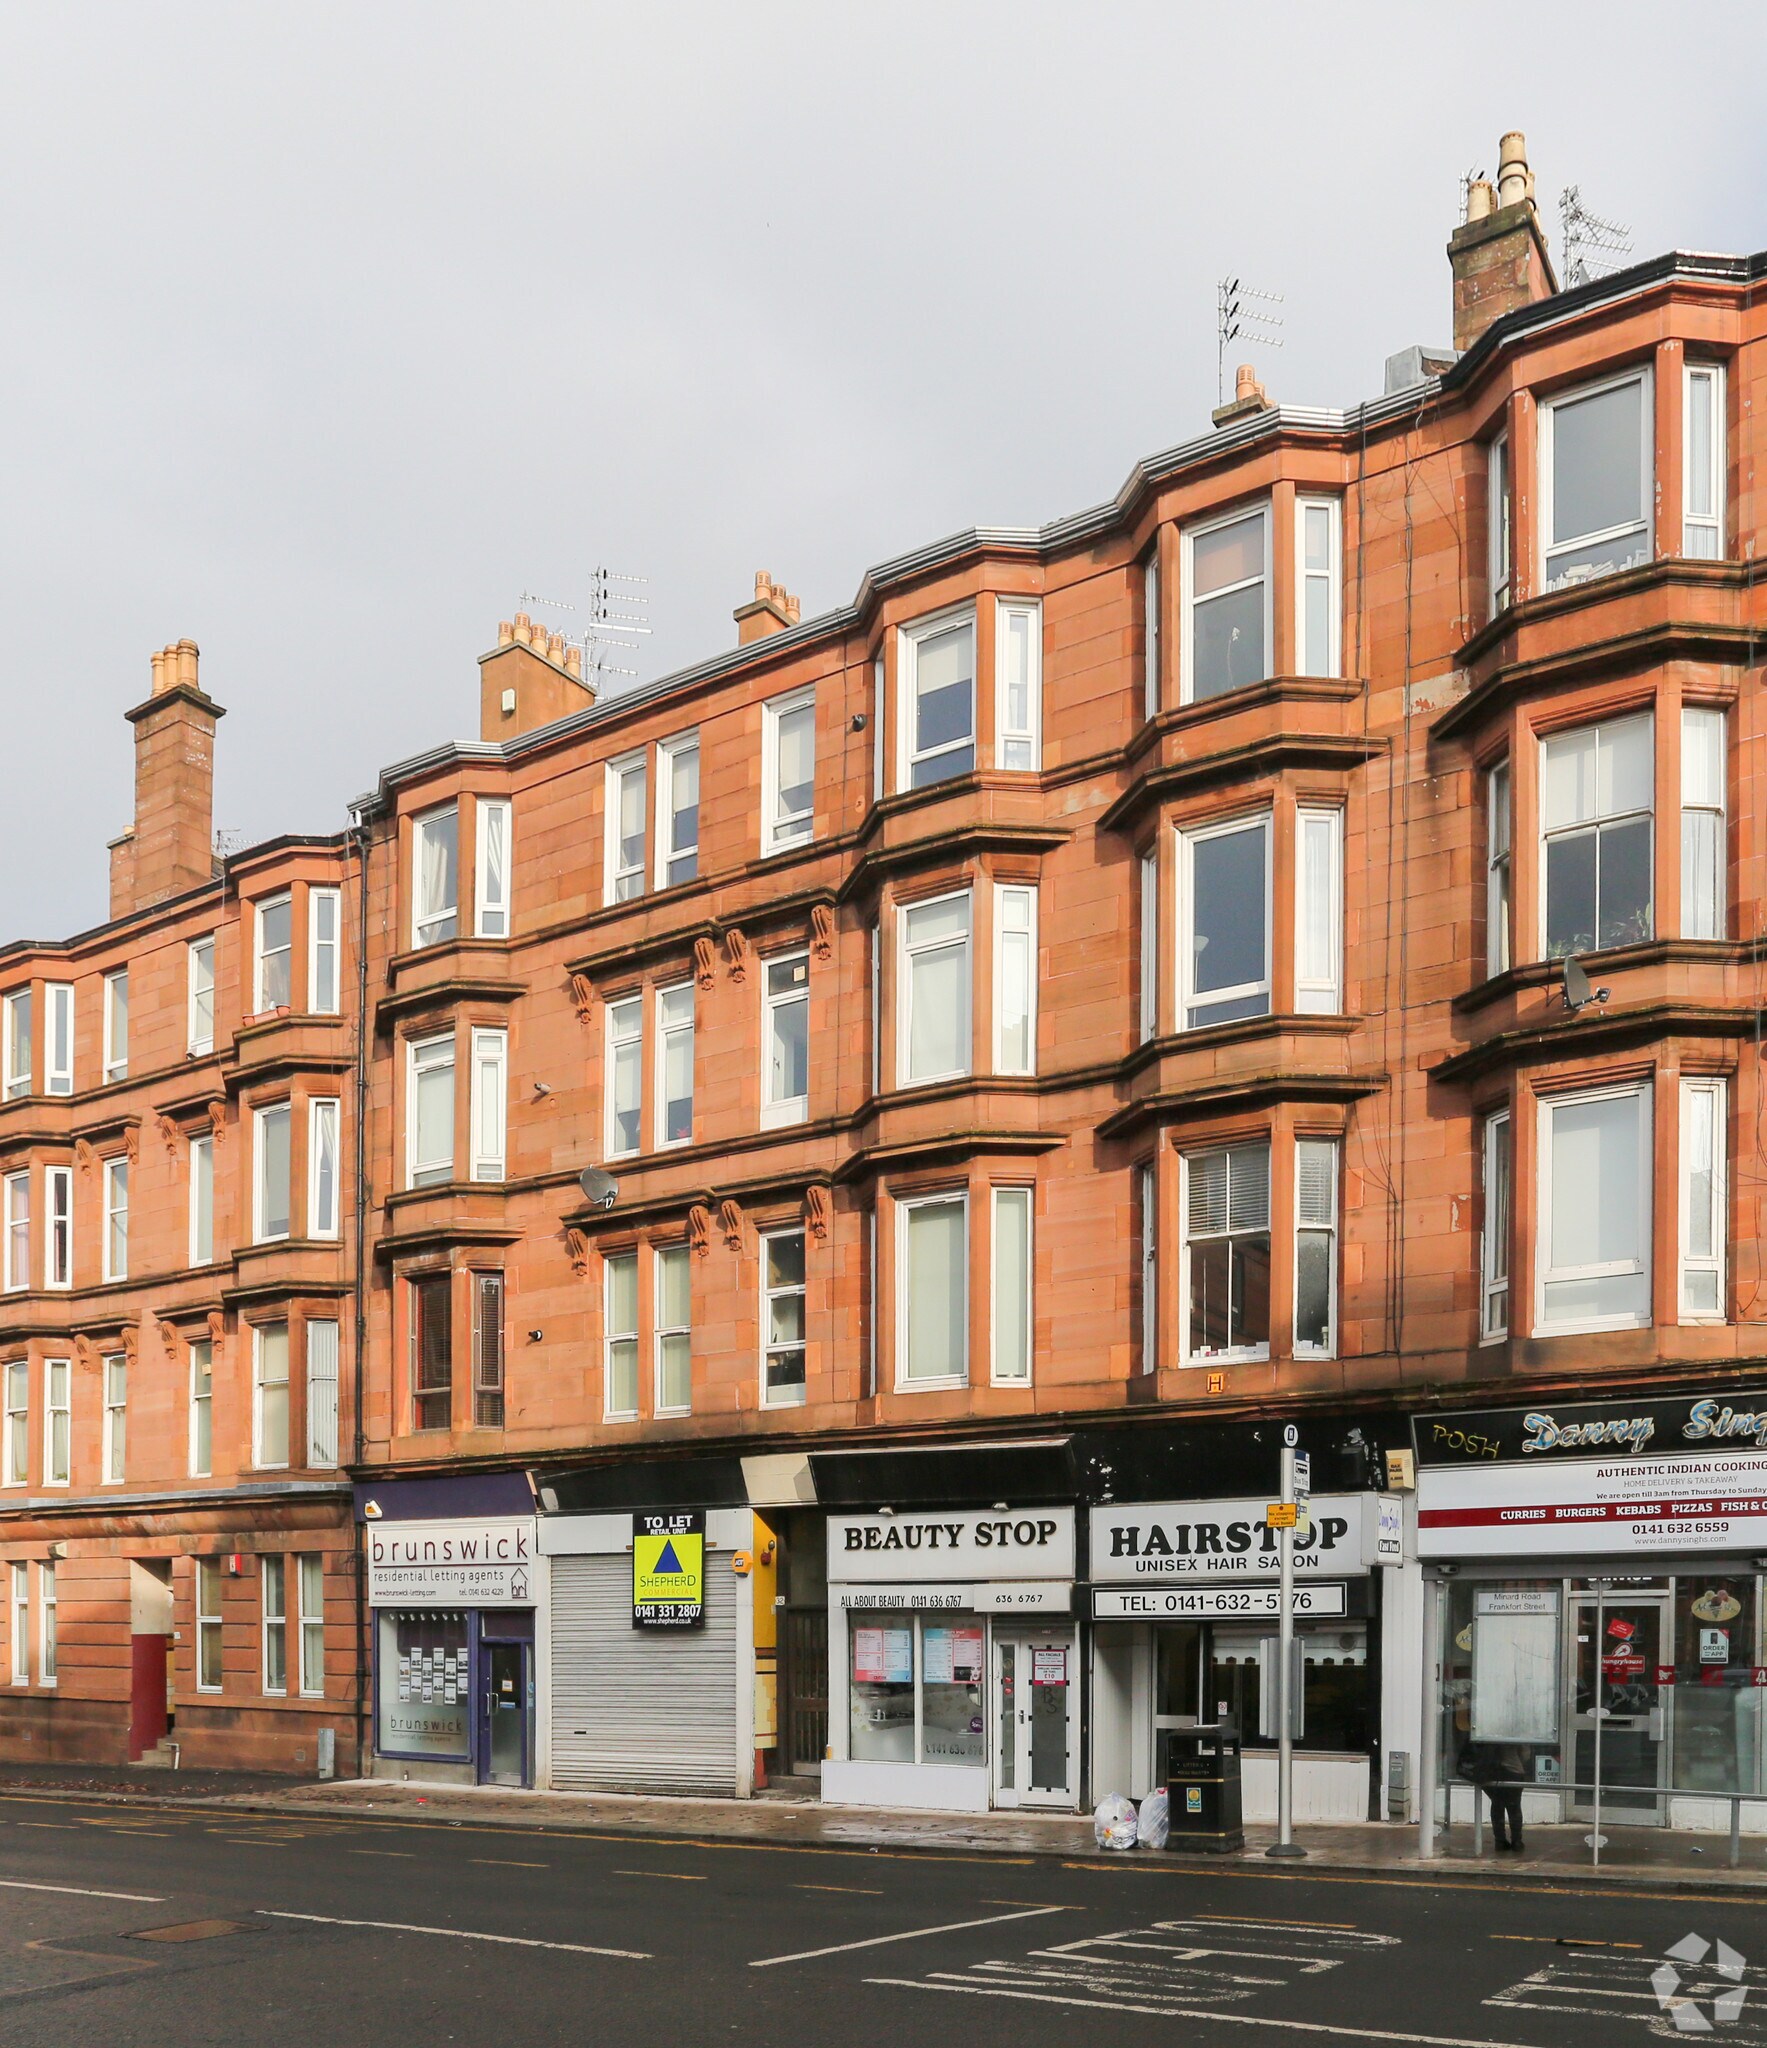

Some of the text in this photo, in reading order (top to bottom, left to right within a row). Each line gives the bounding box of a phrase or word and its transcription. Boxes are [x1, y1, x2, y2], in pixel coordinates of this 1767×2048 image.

[1522, 1412, 1654, 1453] Danny
[1433, 1424, 1500, 1459] POSH
[1596, 1460, 1767, 1478] AUTHENTIC INDIAN COOKING
[1623, 1475, 1739, 1488] HOME DELIVERY & TAKEAWAY
[1621, 1492, 1641, 1501] open
[1641, 1490, 1653, 1498] till
[1653, 1490, 1670, 1498] 3am
[1671, 1489, 1690, 1497] from
[1691, 1487, 1727, 1497] Thursday
[1738, 1485, 1767, 1496] Sunday
[1500, 1509, 1546, 1521] CURRIES
[1555, 1507, 1607, 1519] BURGERS
[1616, 1504, 1662, 1517] KEBABS
[1671, 1502, 1713, 1514] PIZZAS
[1720, 1501, 1748, 1512] FISH
[1750, 1500, 1760, 1510] &
[644, 1515, 693, 1528] TO LET
[1632, 1521, 1729, 1535] 0141 632 6559
[650, 1527, 687, 1536] RETAIL UNIT
[844, 1520, 1057, 1551] BEAUTY STOP
[373, 1528, 528, 1562] brunswick
[1634, 1535, 1727, 1546] www.dannysinghs.com
[1135, 1555, 1319, 1572] UNISEX HAIR SAON
[374, 1568, 504, 1583] residential letting agents
[640, 1574, 697, 1588] SHEPHERD
[468, 1588, 480, 1596] 0141
[480, 1588, 490, 1596] 632
[491, 1588, 504, 1596] 4229
[643, 1588, 693, 1597] COMMERCIAL
[995, 1594, 1043, 1603] 636 6767
[840, 1595, 962, 1607] ALL ABOUT BEAUTY 0141 636 6767
[1120, 1592, 1312, 1612] TEL: 0141-632-576
[635, 1605, 701, 1618] 0141 331 2807
[643, 1617, 692, 1626] www.shepherd.co.uk
[391, 1715, 462, 1732] brunswick
